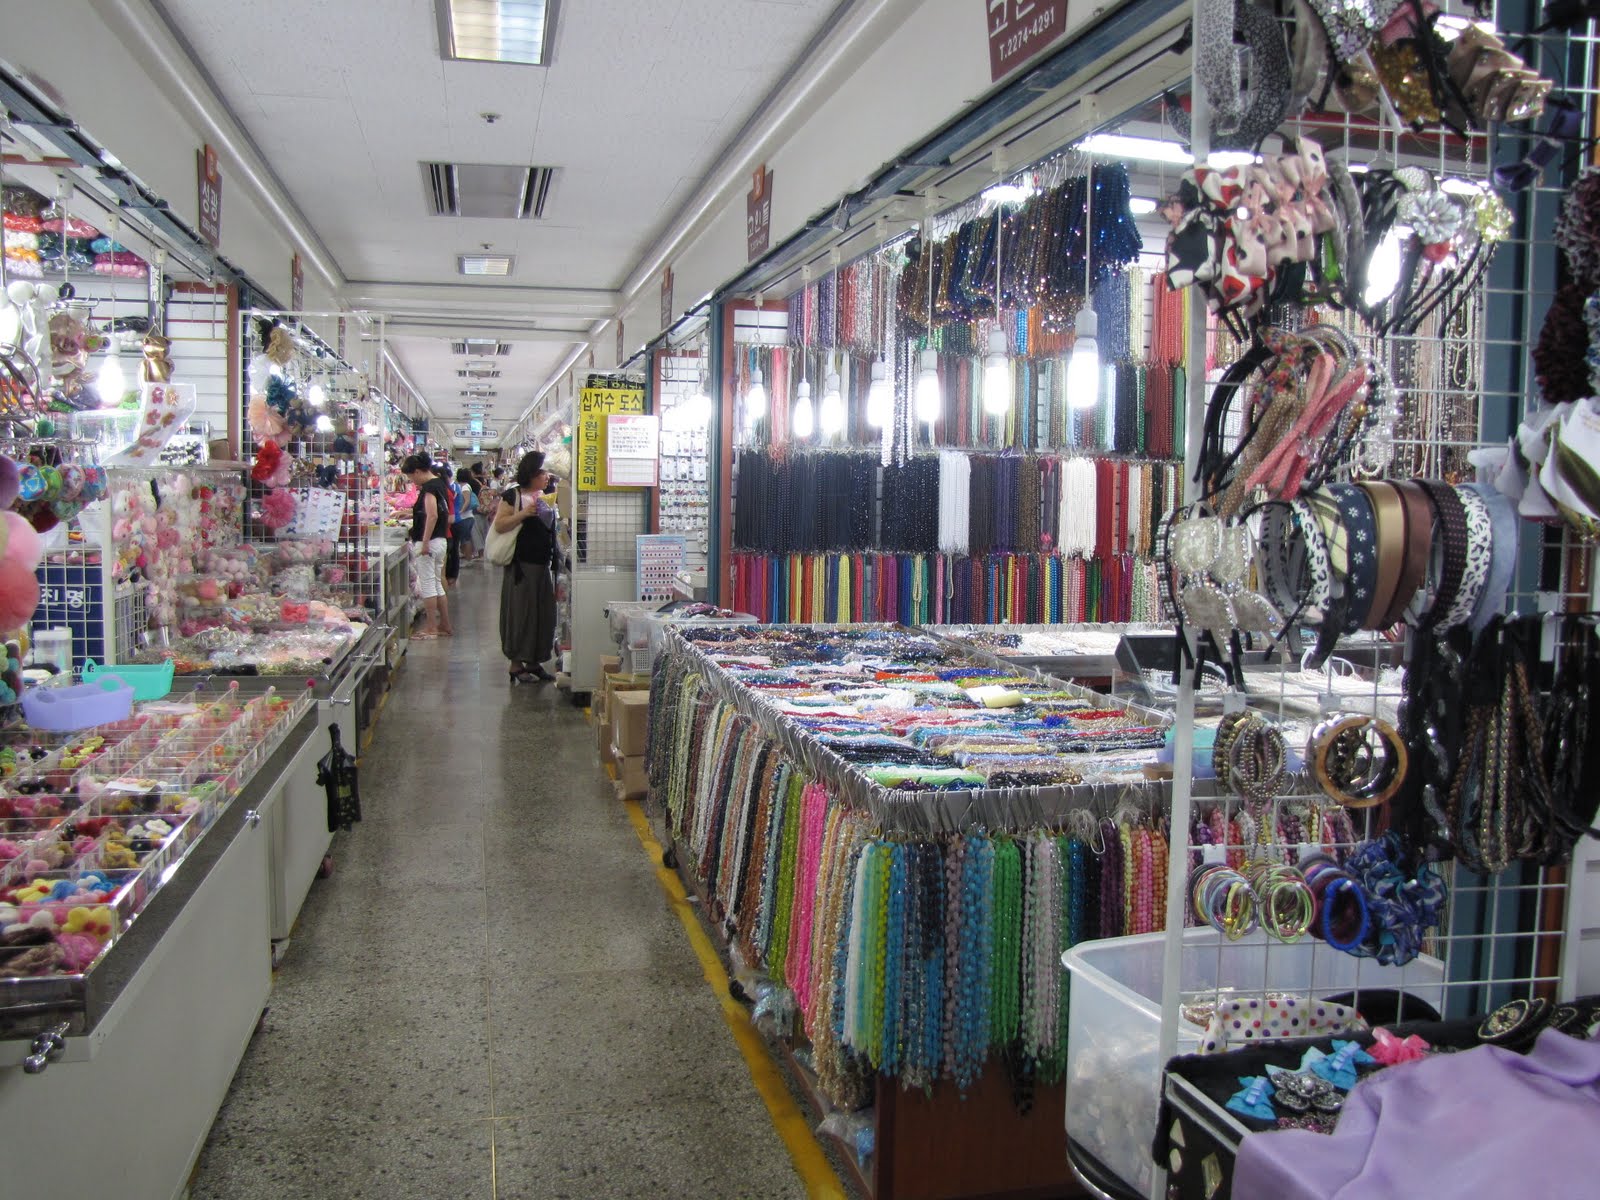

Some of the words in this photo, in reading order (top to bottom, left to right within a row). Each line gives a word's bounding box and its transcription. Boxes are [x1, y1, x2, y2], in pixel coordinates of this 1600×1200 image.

[999, 6, 1055, 61] T.2274-4291
[582, 392, 615, 413] 십자수
[619, 394, 646, 413] 도소
[584, 421, 599, 441] 원단
[582, 445, 599, 486] 공장직매
